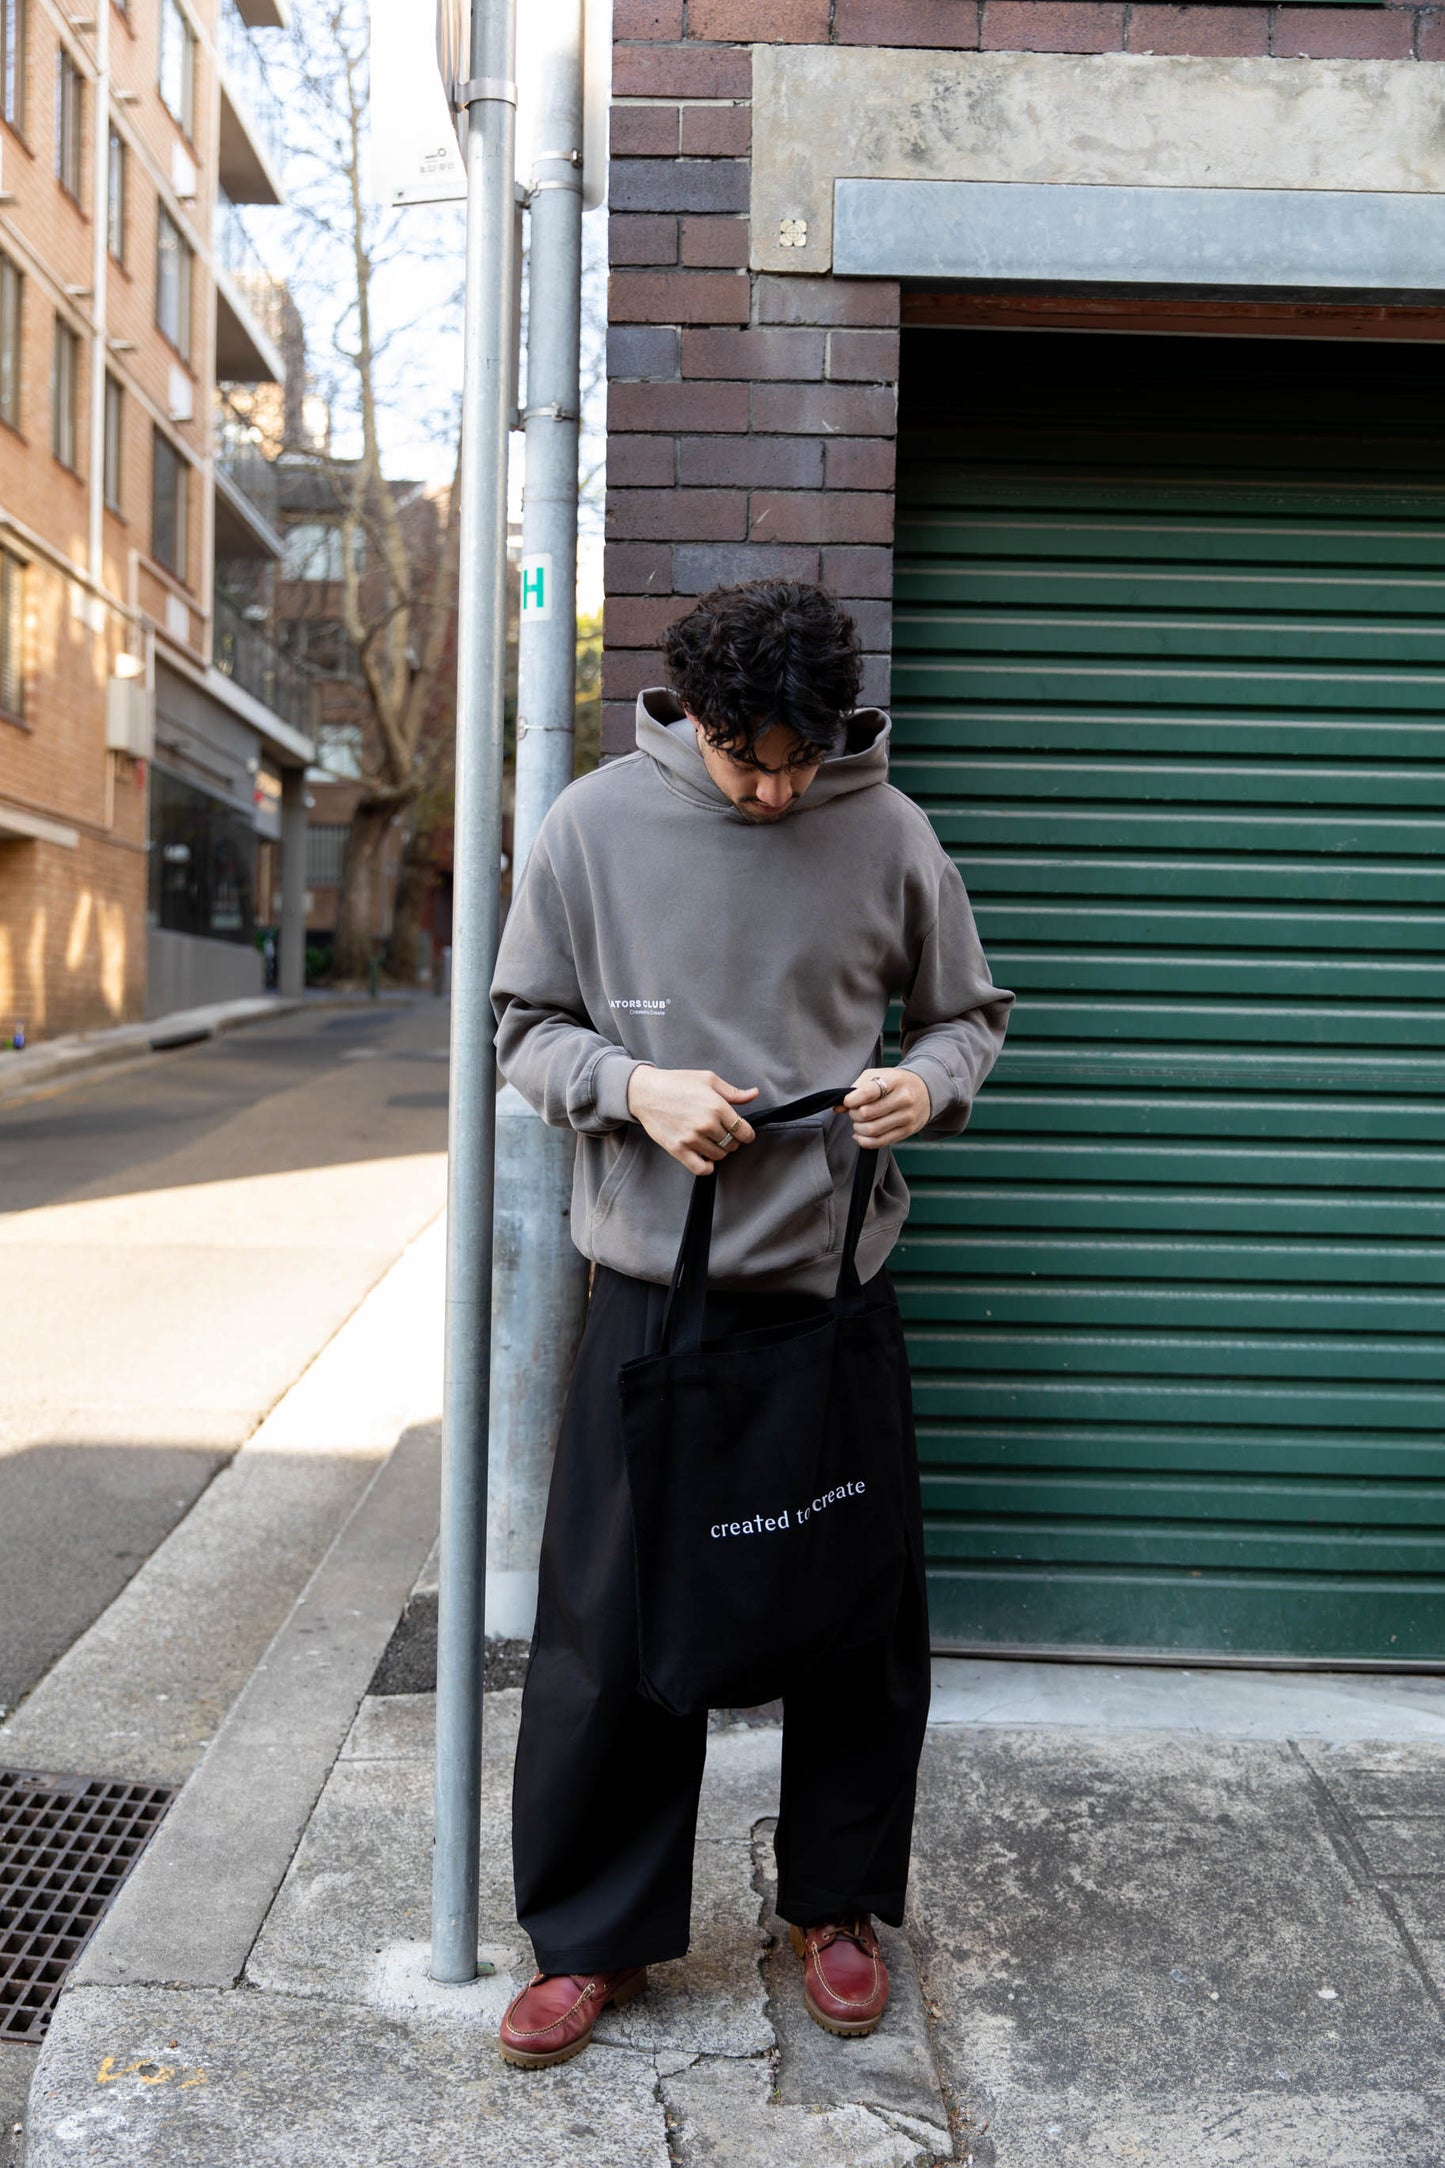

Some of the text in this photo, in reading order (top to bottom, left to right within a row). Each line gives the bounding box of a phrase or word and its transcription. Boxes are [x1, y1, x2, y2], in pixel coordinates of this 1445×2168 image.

[608, 1000, 642, 1008] ATORS
[710, 1480, 866, 1538] created to create
